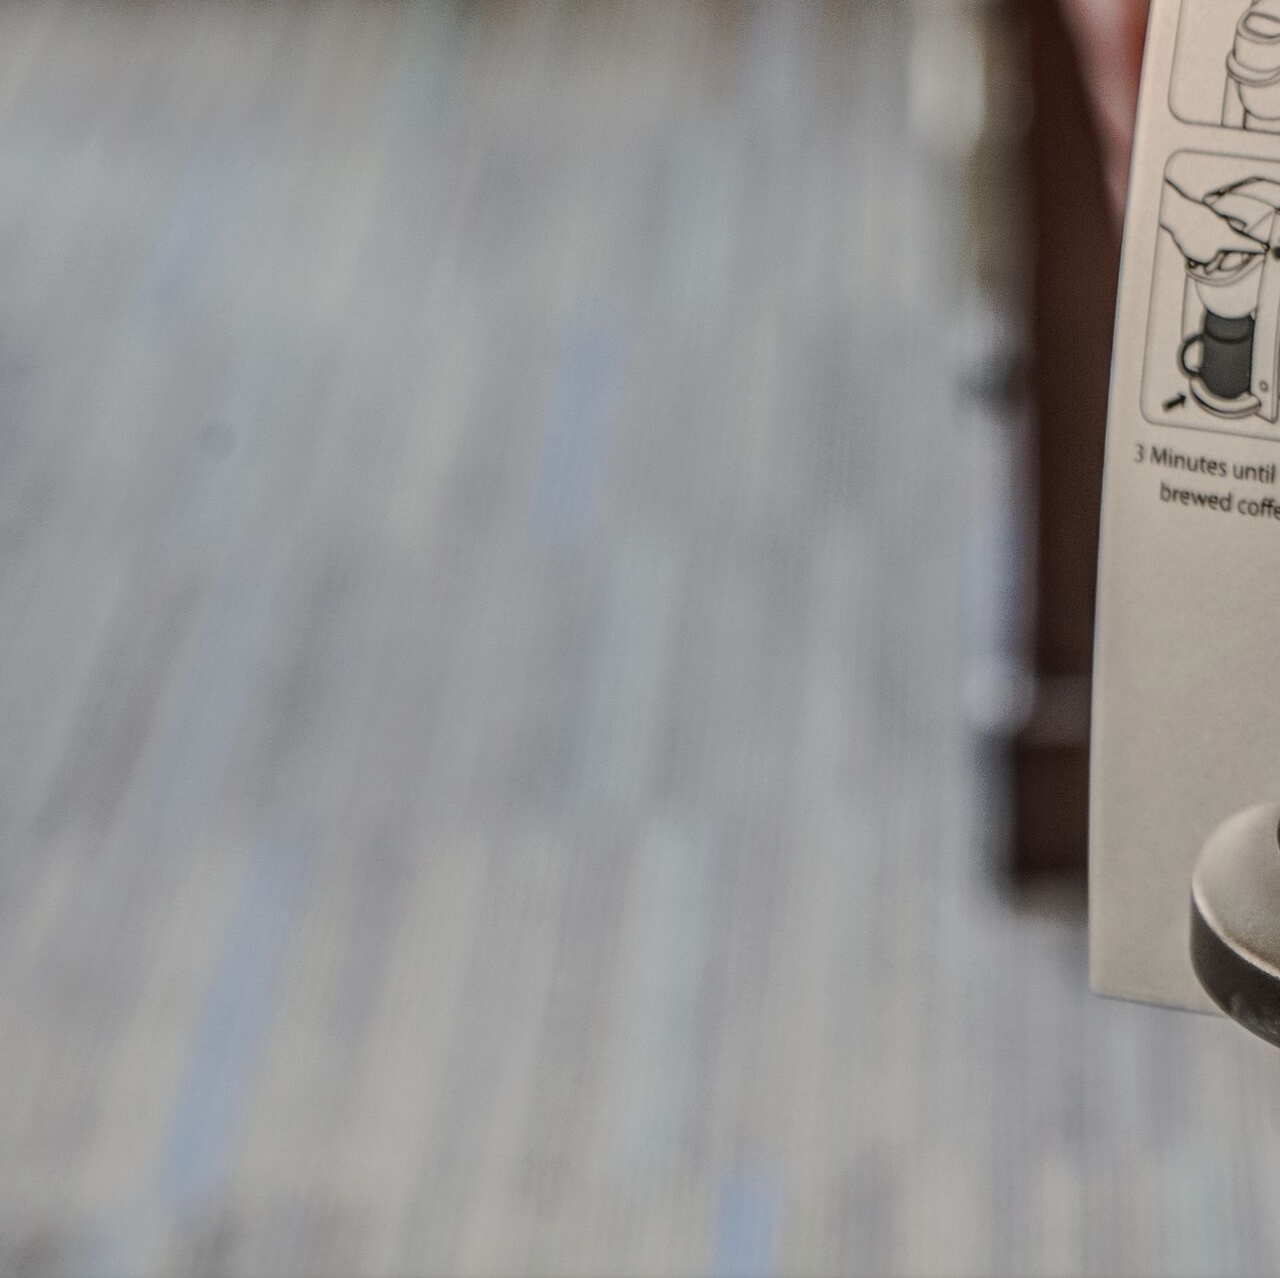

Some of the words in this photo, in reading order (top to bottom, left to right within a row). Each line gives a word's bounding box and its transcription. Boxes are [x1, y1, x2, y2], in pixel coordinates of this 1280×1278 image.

[1134, 444, 1144, 464] 3
[1151, 446, 1227, 478] Minutes
[1232, 462, 1276, 485] until
[1160, 482, 1233, 512] brewed
